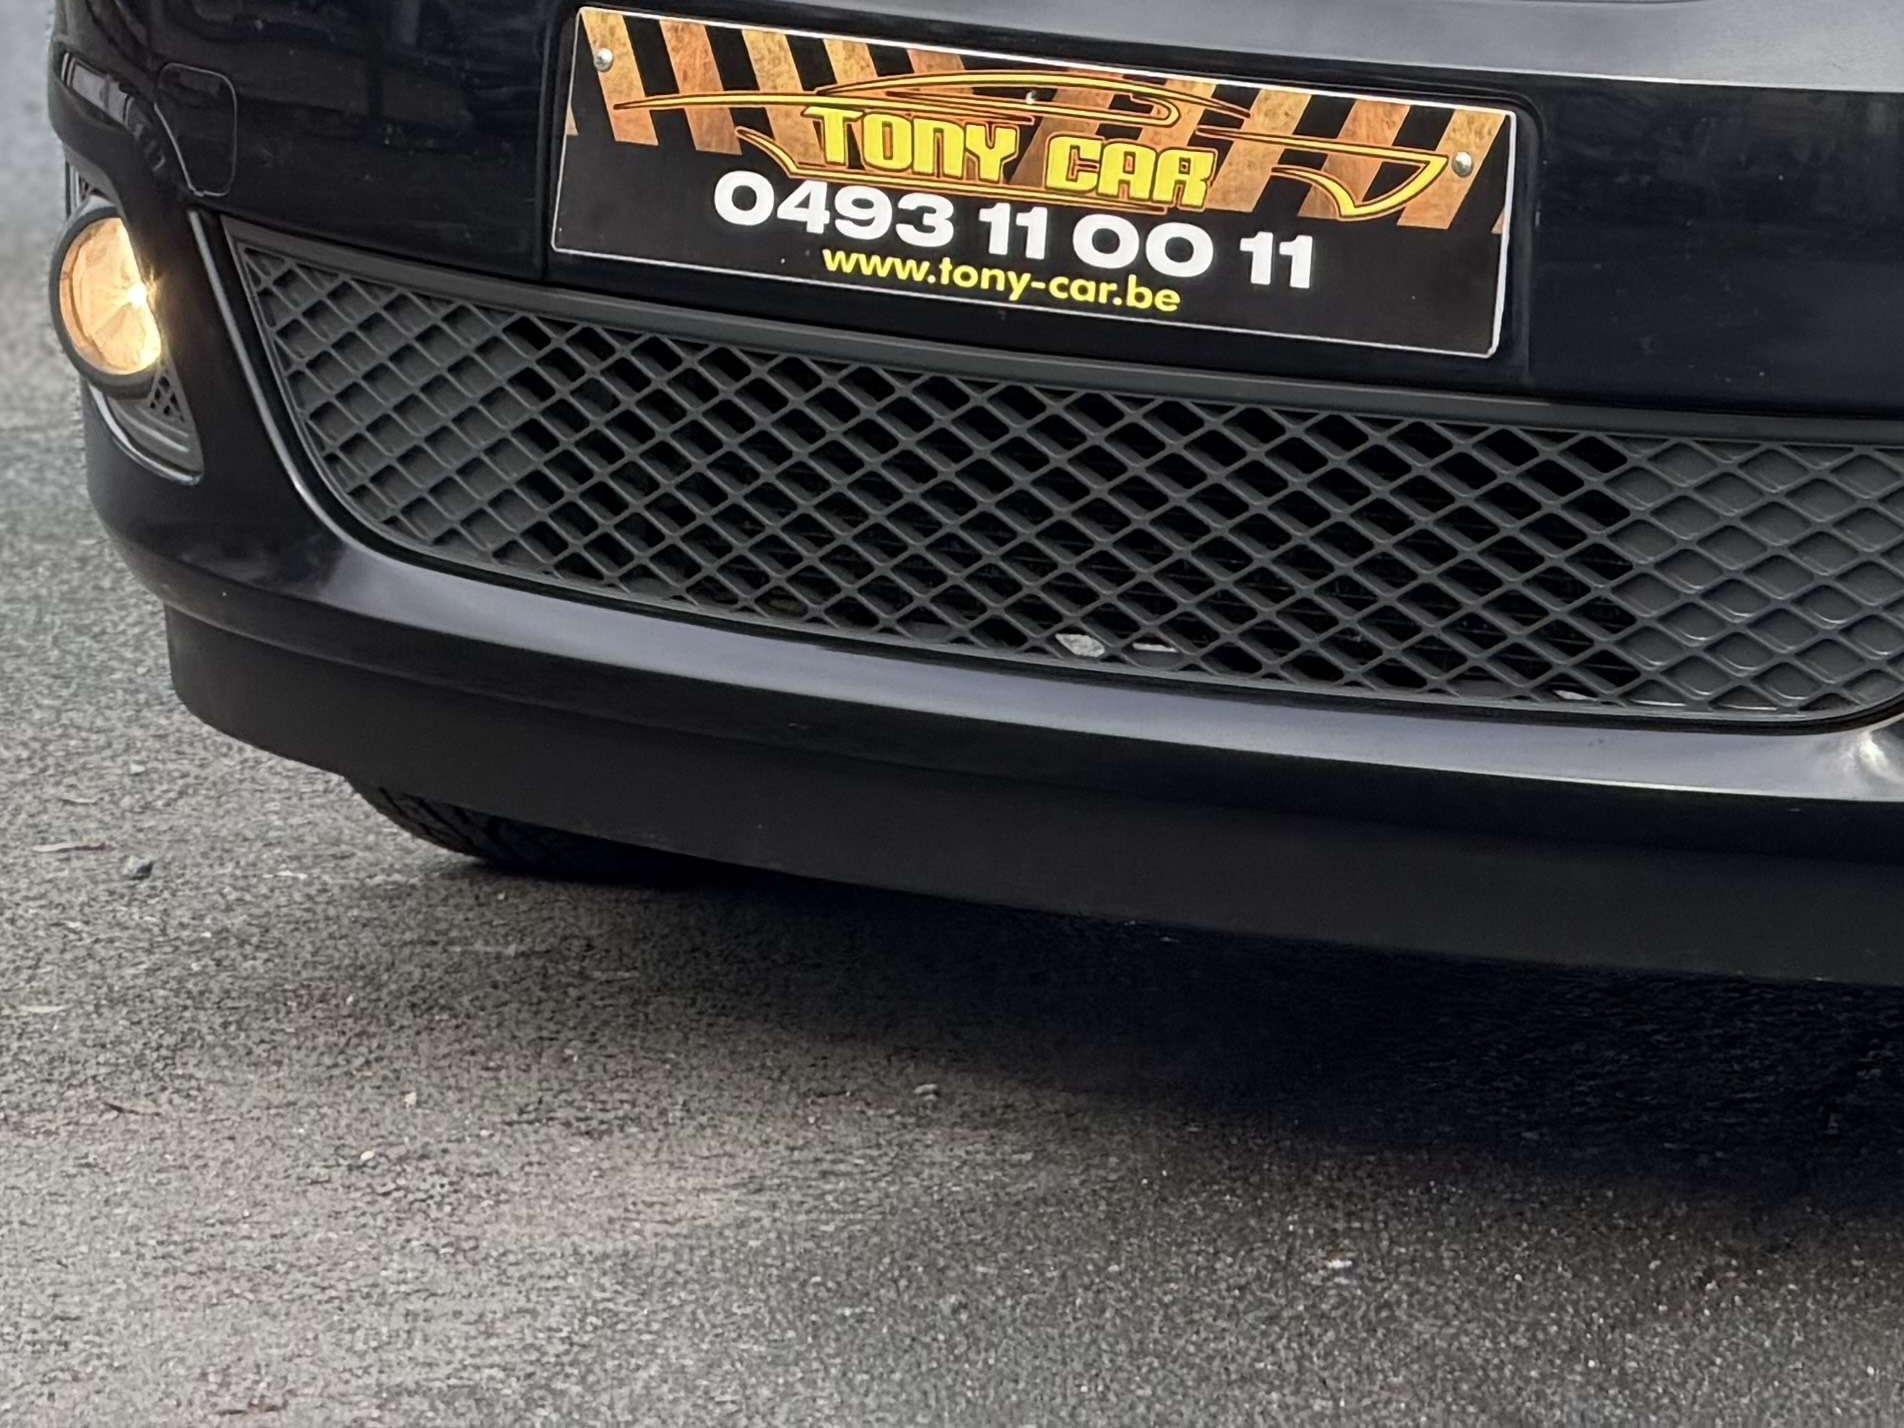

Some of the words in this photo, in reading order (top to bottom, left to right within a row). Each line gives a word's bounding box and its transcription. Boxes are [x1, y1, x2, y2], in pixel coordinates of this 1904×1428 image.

[803, 105, 1020, 184] TONY
[1044, 134, 1217, 209] CAR
[713, 169, 955, 248] 0493
[979, 200, 1050, 260] 11
[1071, 213, 1216, 278] 00
[1239, 230, 1314, 289] 11
[821, 245, 1182, 313] www.tony-car.be
